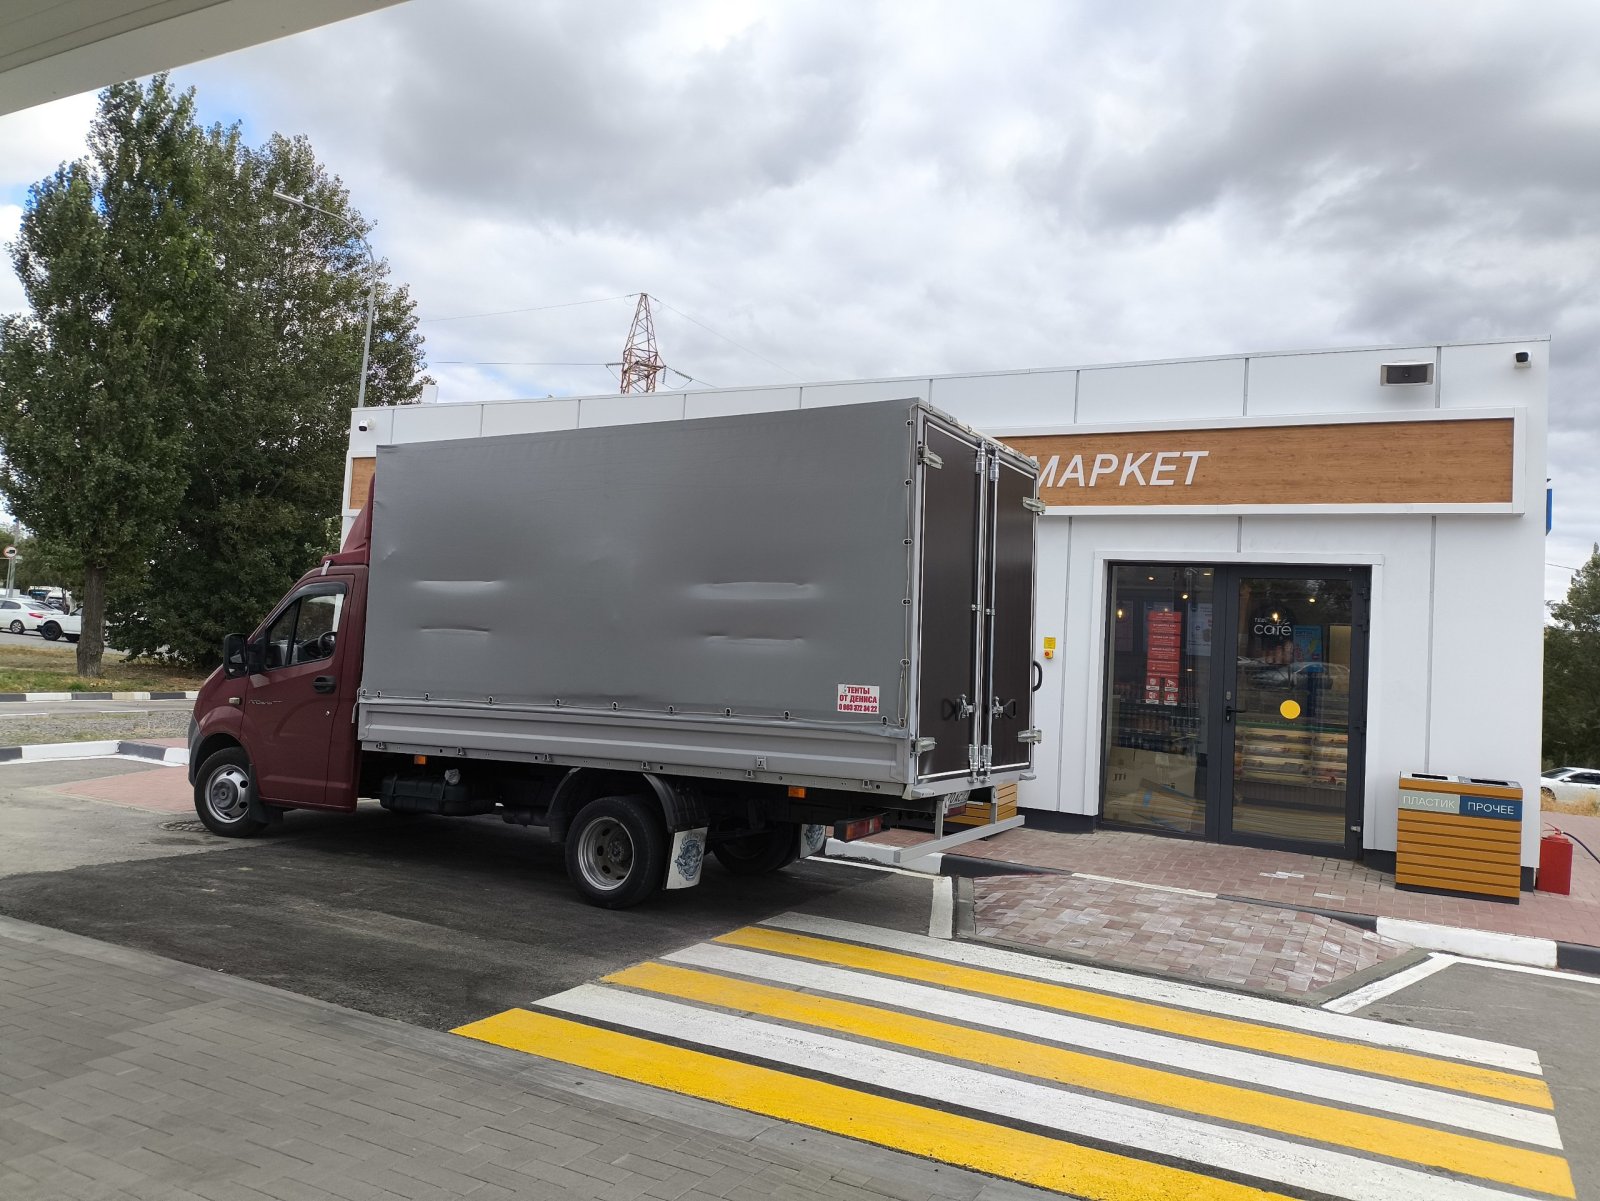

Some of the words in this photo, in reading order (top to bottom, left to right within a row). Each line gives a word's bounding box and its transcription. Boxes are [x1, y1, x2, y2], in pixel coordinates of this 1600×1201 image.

[1030, 451, 1209, 488] МАРКЕТ
[1403, 795, 1455, 809] ПЛАСТИК
[1467, 801, 1515, 815] ПРОЧЕЕ
